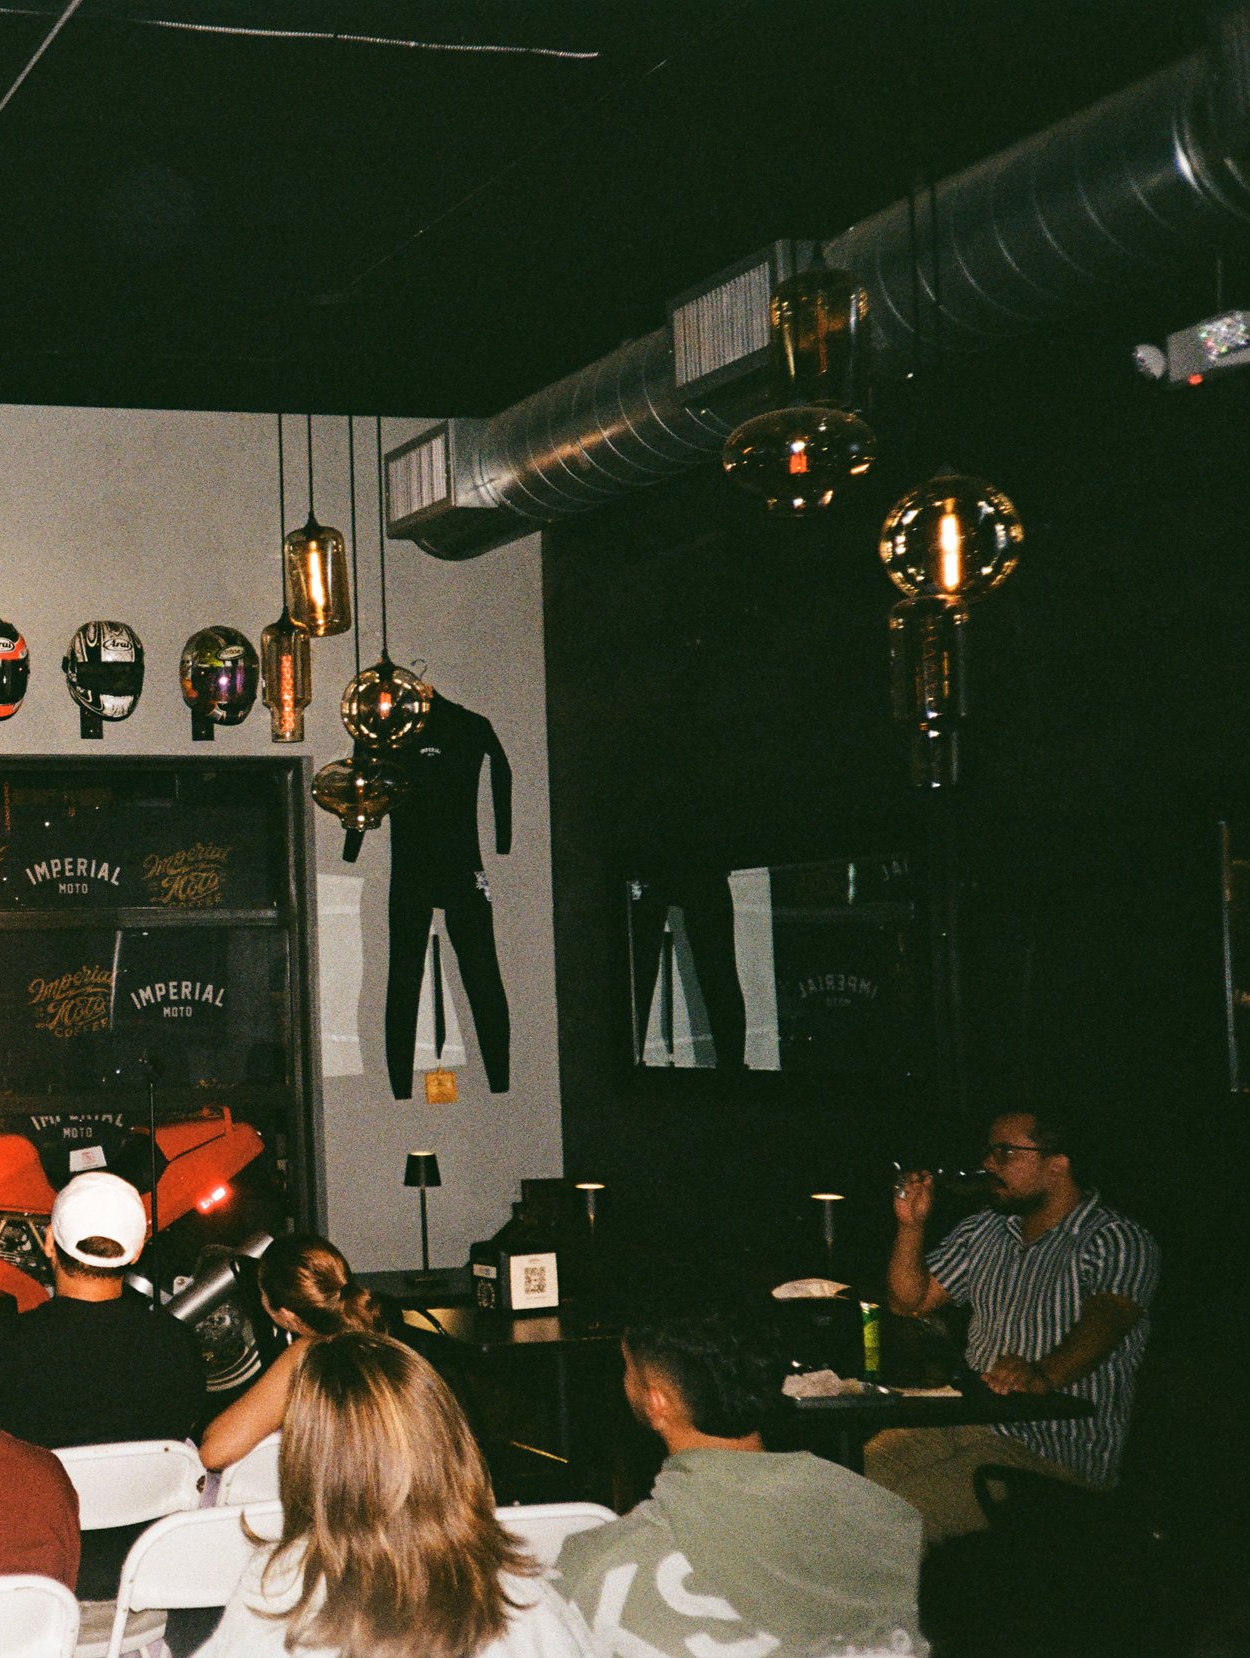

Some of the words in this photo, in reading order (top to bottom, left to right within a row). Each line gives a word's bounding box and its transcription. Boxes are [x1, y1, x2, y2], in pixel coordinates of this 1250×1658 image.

[108, 639, 131, 648] Arai
[25, 857, 121, 886] IMPERIAL
[59, 883, 88, 894] MOTO
[130, 981, 226, 1009] IMPERIAL
[163, 1006, 193, 1018] MOTO
[62, 1127, 93, 1139] MOTO
